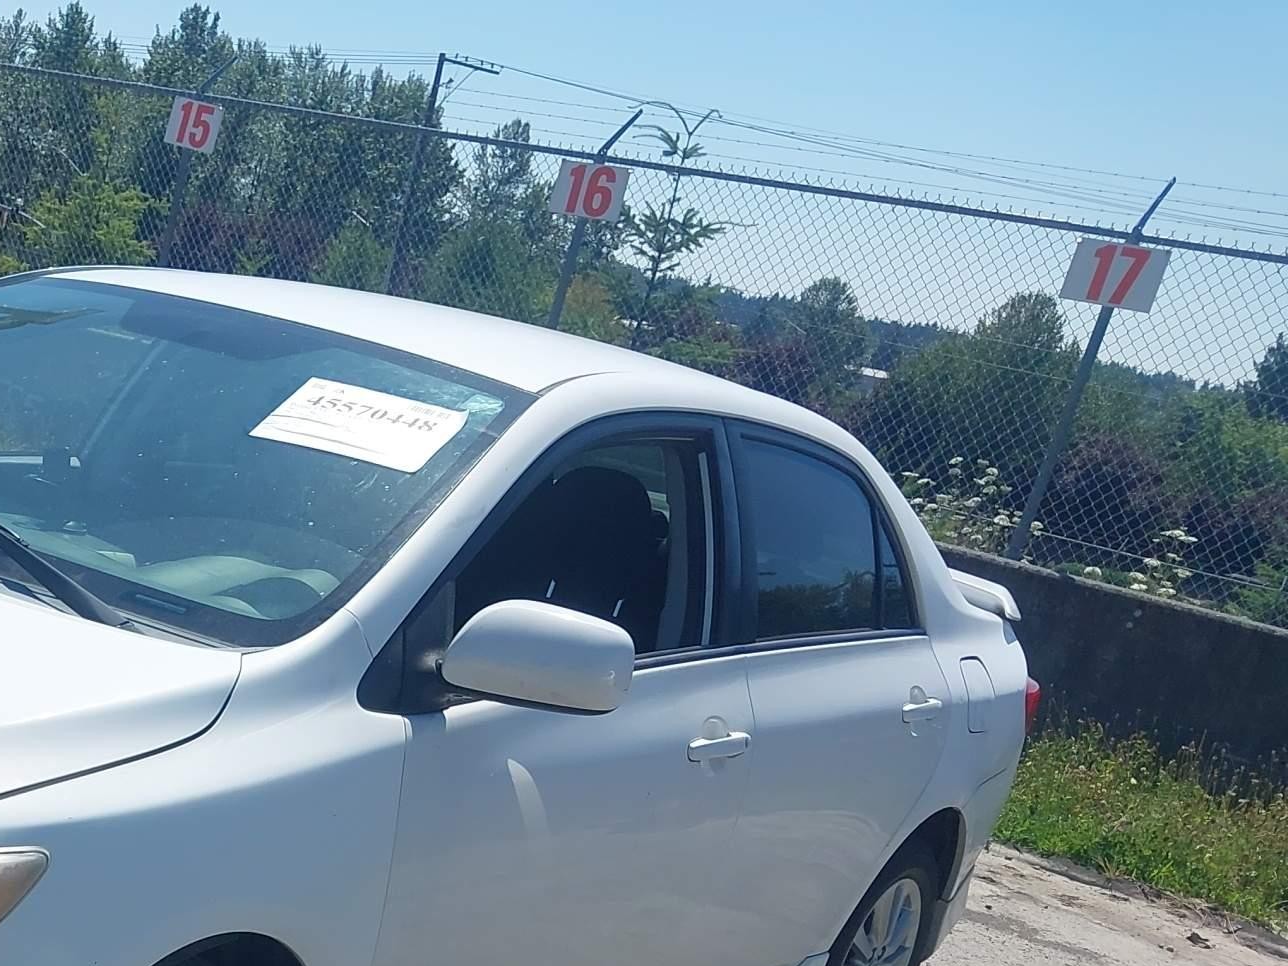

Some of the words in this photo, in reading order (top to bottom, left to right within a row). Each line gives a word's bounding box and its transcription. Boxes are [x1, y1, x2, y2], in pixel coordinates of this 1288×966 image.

[176, 100, 216, 149] 15
[565, 164, 617, 218] 16
[1086, 244, 1152, 305] 17
[306, 395, 439, 432] 45570448
